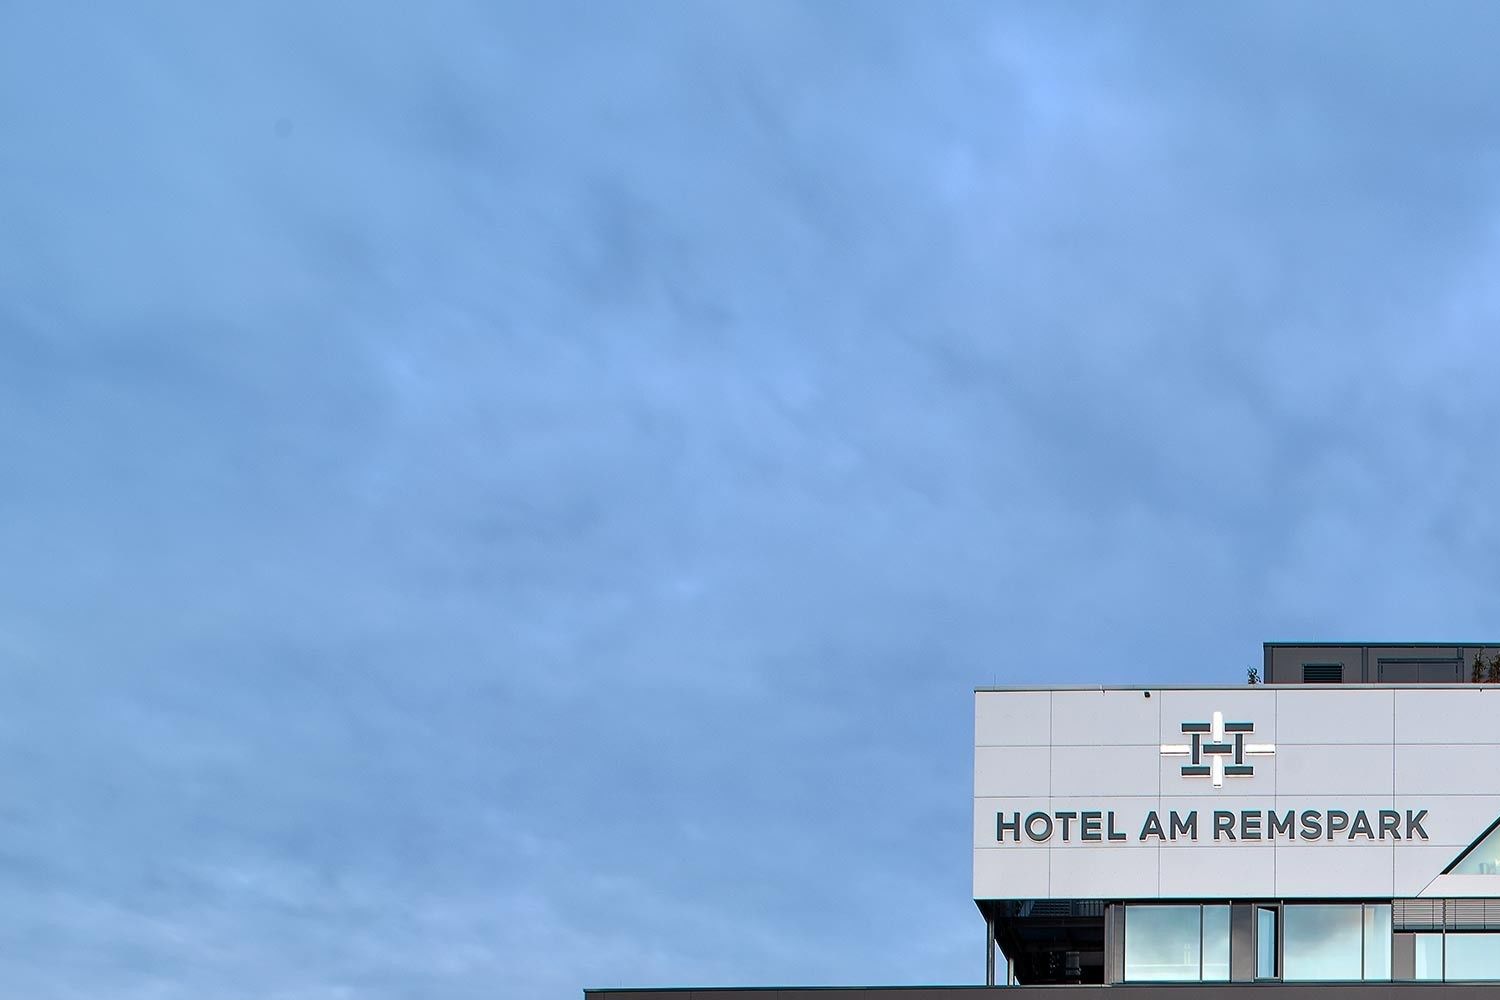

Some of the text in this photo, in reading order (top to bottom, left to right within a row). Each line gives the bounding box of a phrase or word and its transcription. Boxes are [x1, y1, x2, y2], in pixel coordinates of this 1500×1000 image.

[995, 809, 1430, 842] HOTEL AM REMSPARK
